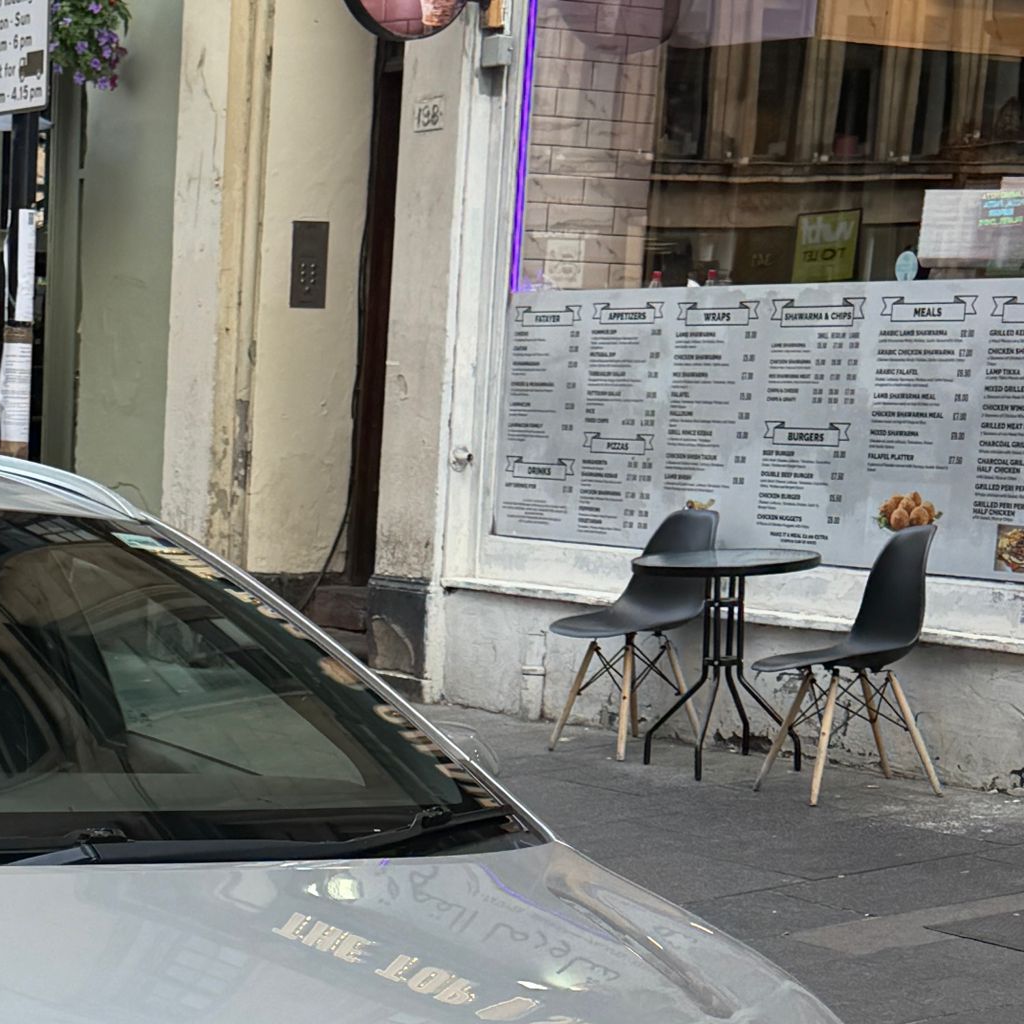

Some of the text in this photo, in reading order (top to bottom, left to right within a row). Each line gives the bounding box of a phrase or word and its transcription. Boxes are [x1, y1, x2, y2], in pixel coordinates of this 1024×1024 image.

[15, 11, 31, 27] Sun
[13, 34, 19, 49] 6
[20, 36, 32, 51] pm
[4, 62, 16, 77] for
[11, 85, 28, 101] 4.15
[30, 87, 43, 101] pm
[609, 312, 646, 320] APPETIZERS
[704, 312, 731, 321] WRAPS
[784, 312, 823, 320] SHAWARMA
[831, 312, 852, 320] CHIPS
[913, 307, 942, 317] MEALS
[788, 432, 824, 442] BURGERS
[607, 442, 629, 450] PIZZAS
